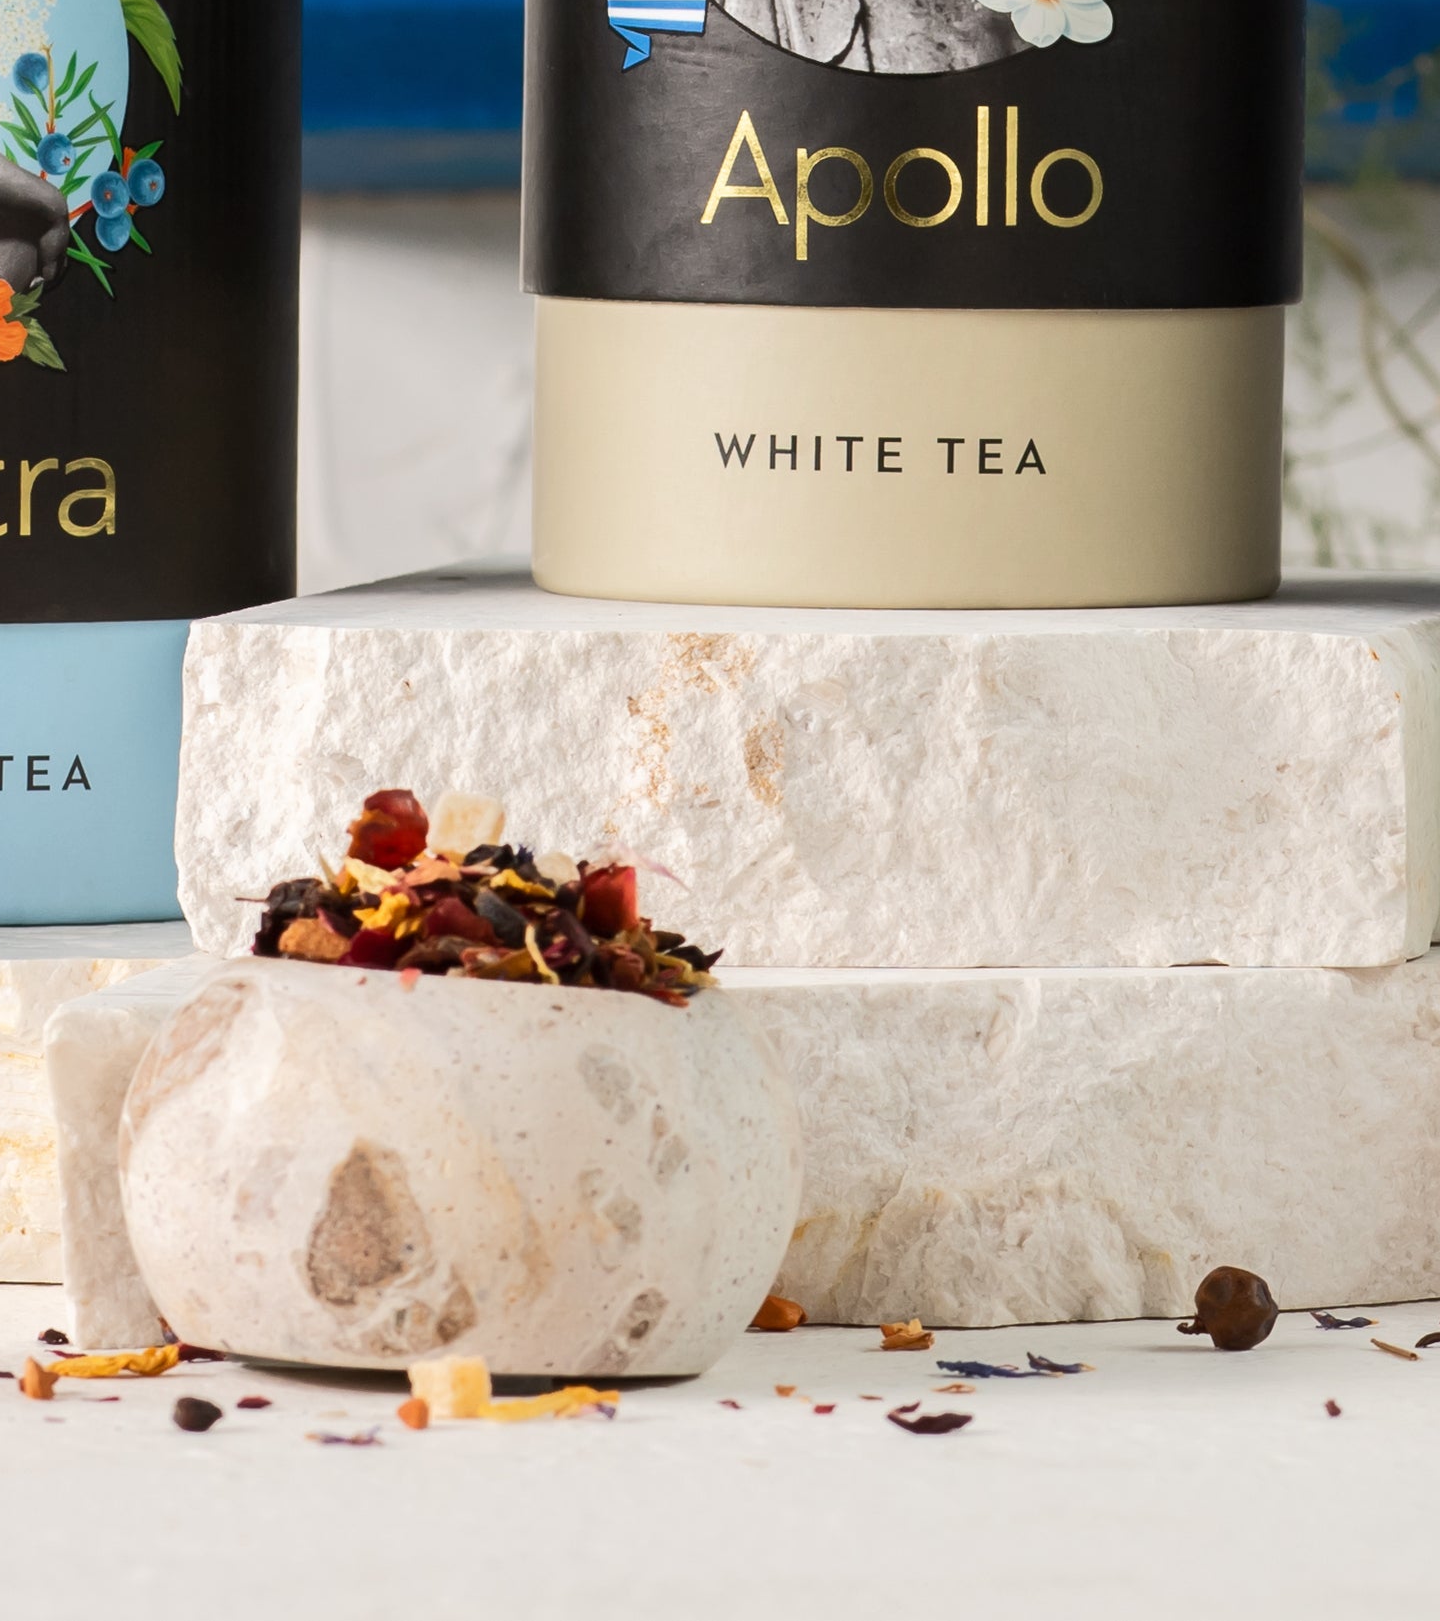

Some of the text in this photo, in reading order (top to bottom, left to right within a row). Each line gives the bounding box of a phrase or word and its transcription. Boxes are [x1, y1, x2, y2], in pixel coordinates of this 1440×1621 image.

[699, 104, 1104, 261] Apollo
[715, 433, 1046, 474] WHITE TEA
